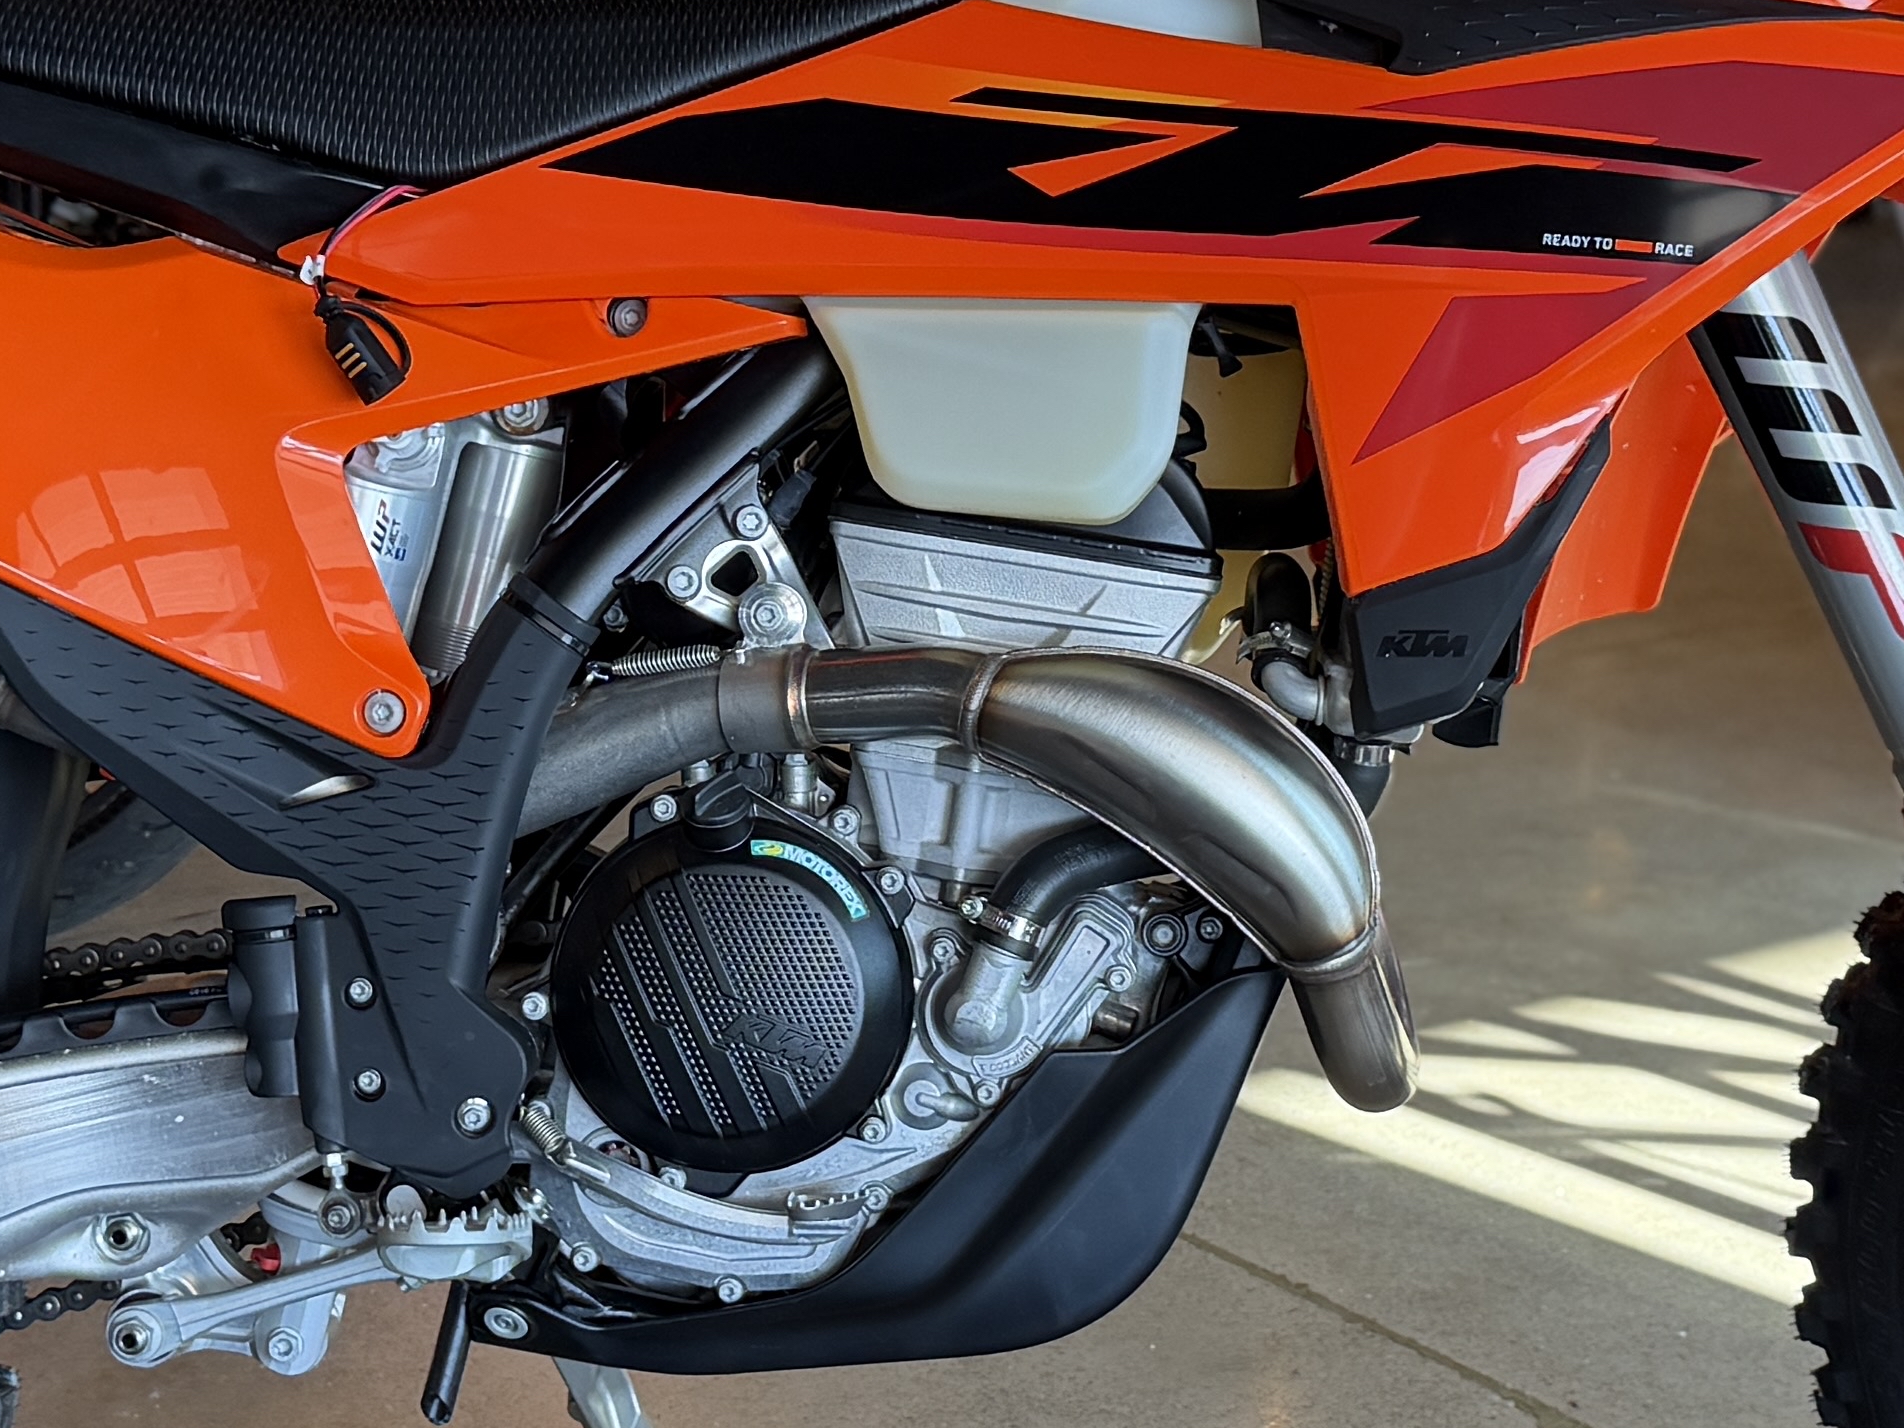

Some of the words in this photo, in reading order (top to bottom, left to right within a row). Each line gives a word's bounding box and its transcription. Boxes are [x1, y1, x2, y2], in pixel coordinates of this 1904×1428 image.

[1542, 233, 1591, 249] READY
[1593, 236, 1613, 251] TO
[1654, 242, 1695, 257] RACE
[370, 498, 390, 556] WP
[1376, 630, 1469, 658] KTM
[783, 844, 869, 919] MOTOREX
[719, 1013, 828, 1069] KTM
